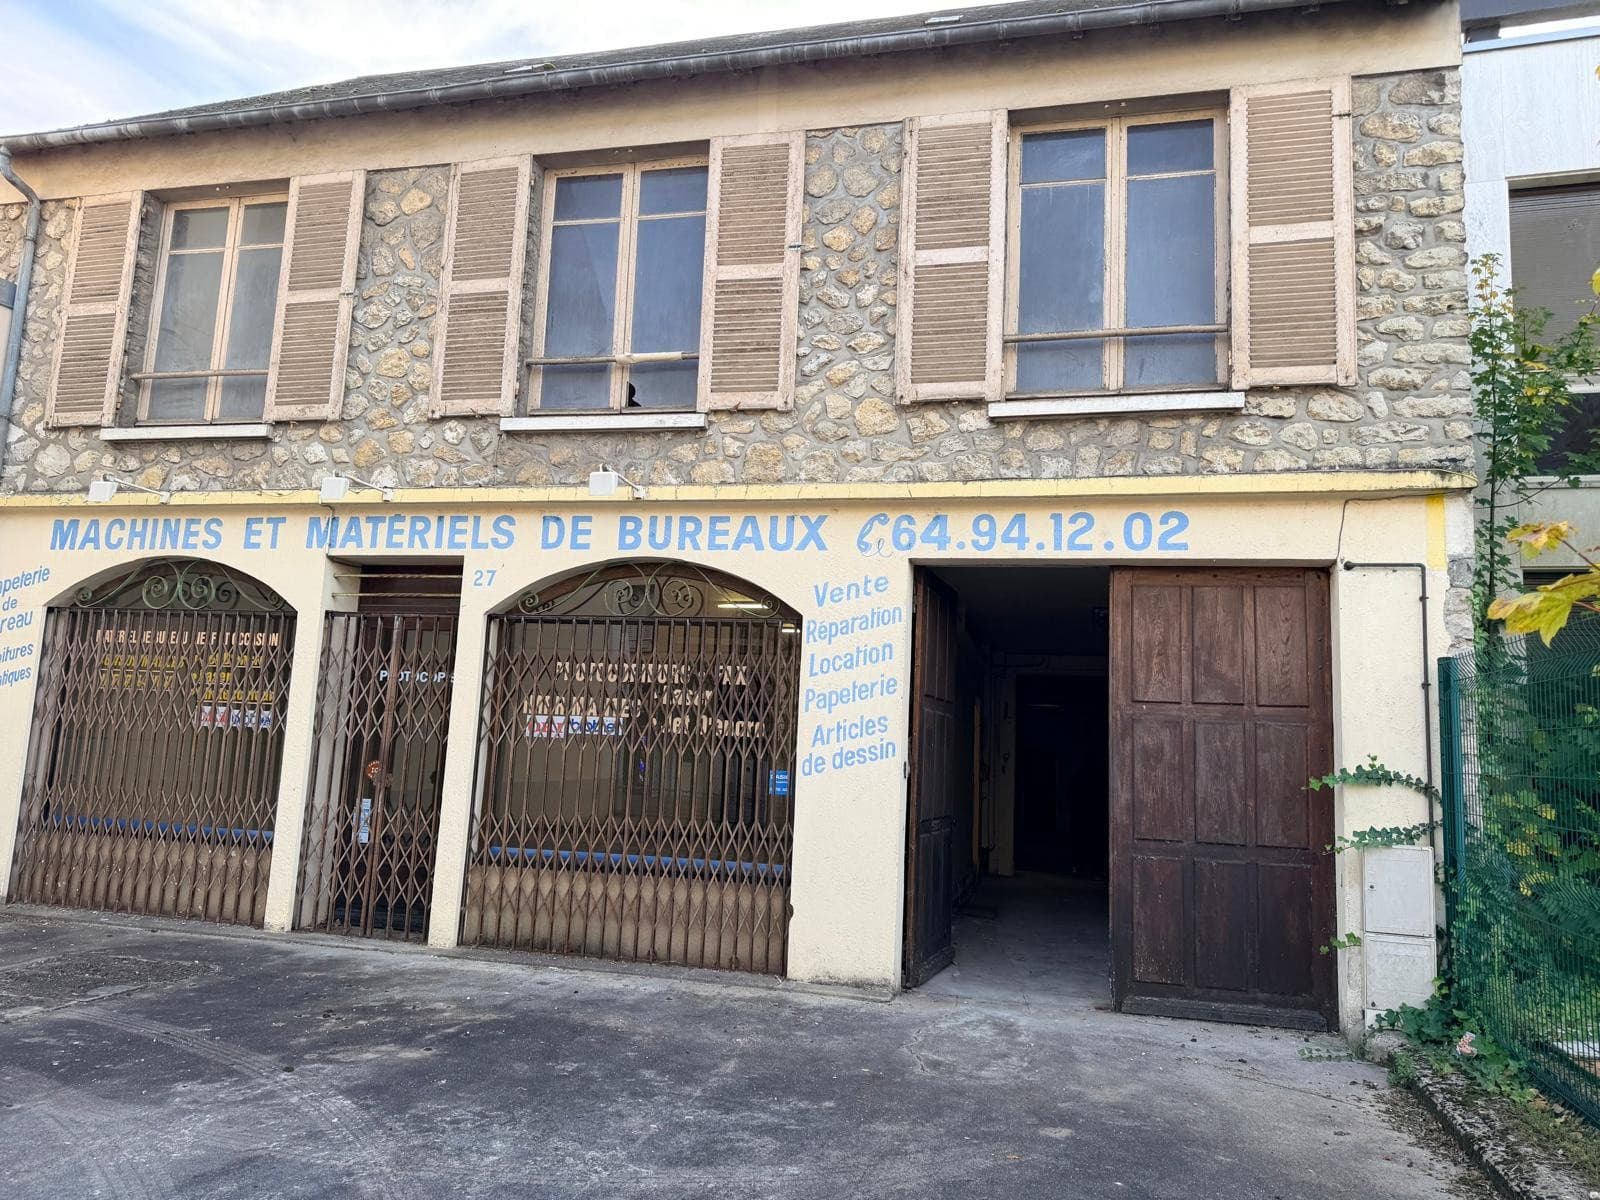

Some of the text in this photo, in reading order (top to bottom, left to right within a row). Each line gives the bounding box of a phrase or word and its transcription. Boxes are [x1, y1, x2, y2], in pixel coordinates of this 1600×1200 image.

[50, 518, 224, 550] MACHINES
[243, 516, 287, 550] ET
[540, 515, 593, 550] DE
[617, 515, 829, 551] BUREAUX
[891, 511, 1190, 552] 64.94.12.02
[473, 569, 497, 587] 27
[813, 574, 890, 608] Vente
[1, 596, 18, 612] de
[805, 606, 903, 646] Réparation
[808, 641, 895, 678] Location
[804, 673, 898, 714] Papeterie
[811, 714, 889, 748] Articles
[801, 737, 897, 777] de dessin
